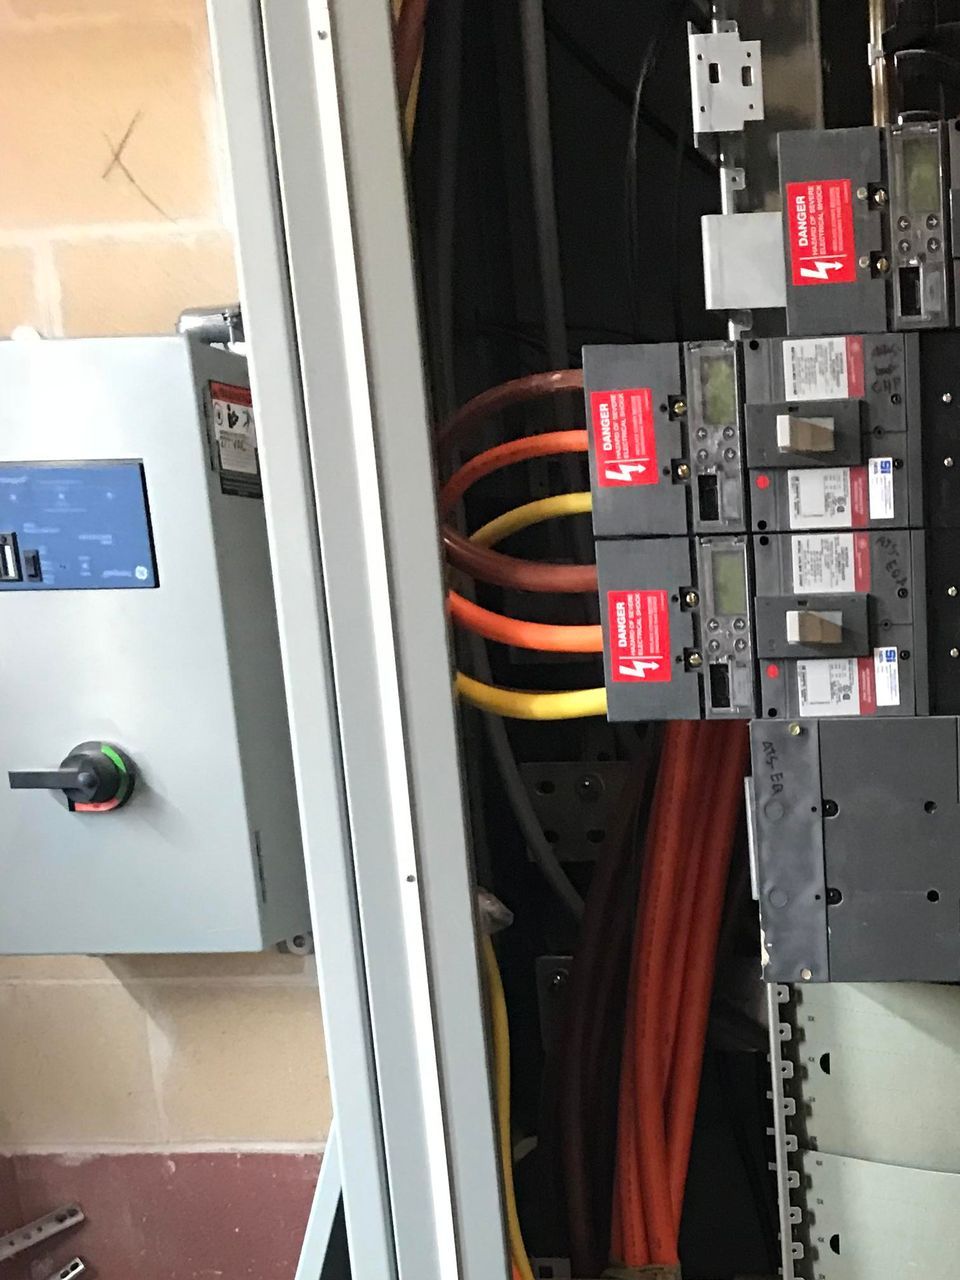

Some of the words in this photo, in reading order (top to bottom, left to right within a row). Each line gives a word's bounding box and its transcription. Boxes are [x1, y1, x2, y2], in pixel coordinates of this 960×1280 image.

[796, 196, 808, 246] DANGER
[810, 227, 818, 255] HAZARD
[600, 404, 612, 450] DANGER
[613, 423, 619, 431] OF
[616, 602, 627, 647] DANGER
